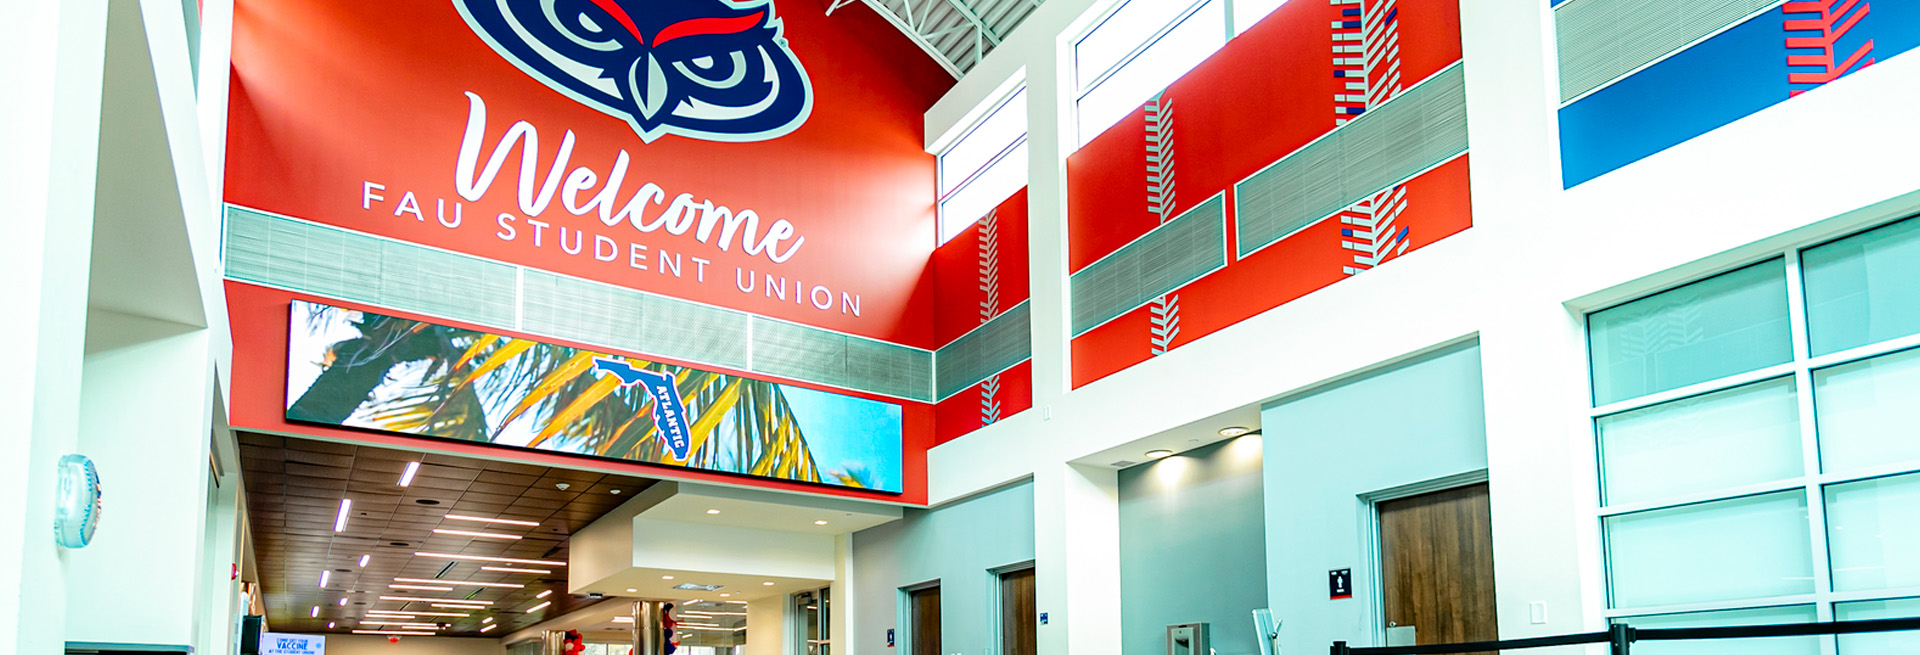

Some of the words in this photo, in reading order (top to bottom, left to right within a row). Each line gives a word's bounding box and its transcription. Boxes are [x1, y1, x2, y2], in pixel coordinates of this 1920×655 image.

[456, 91, 804, 263] Welcome
[363, 181, 463, 229] FAU
[496, 213, 711, 283] STUDENT
[736, 267, 861, 317] UNION
[656, 385, 685, 449] ATLANTIC
[277, 642, 308, 650] VACCINE
